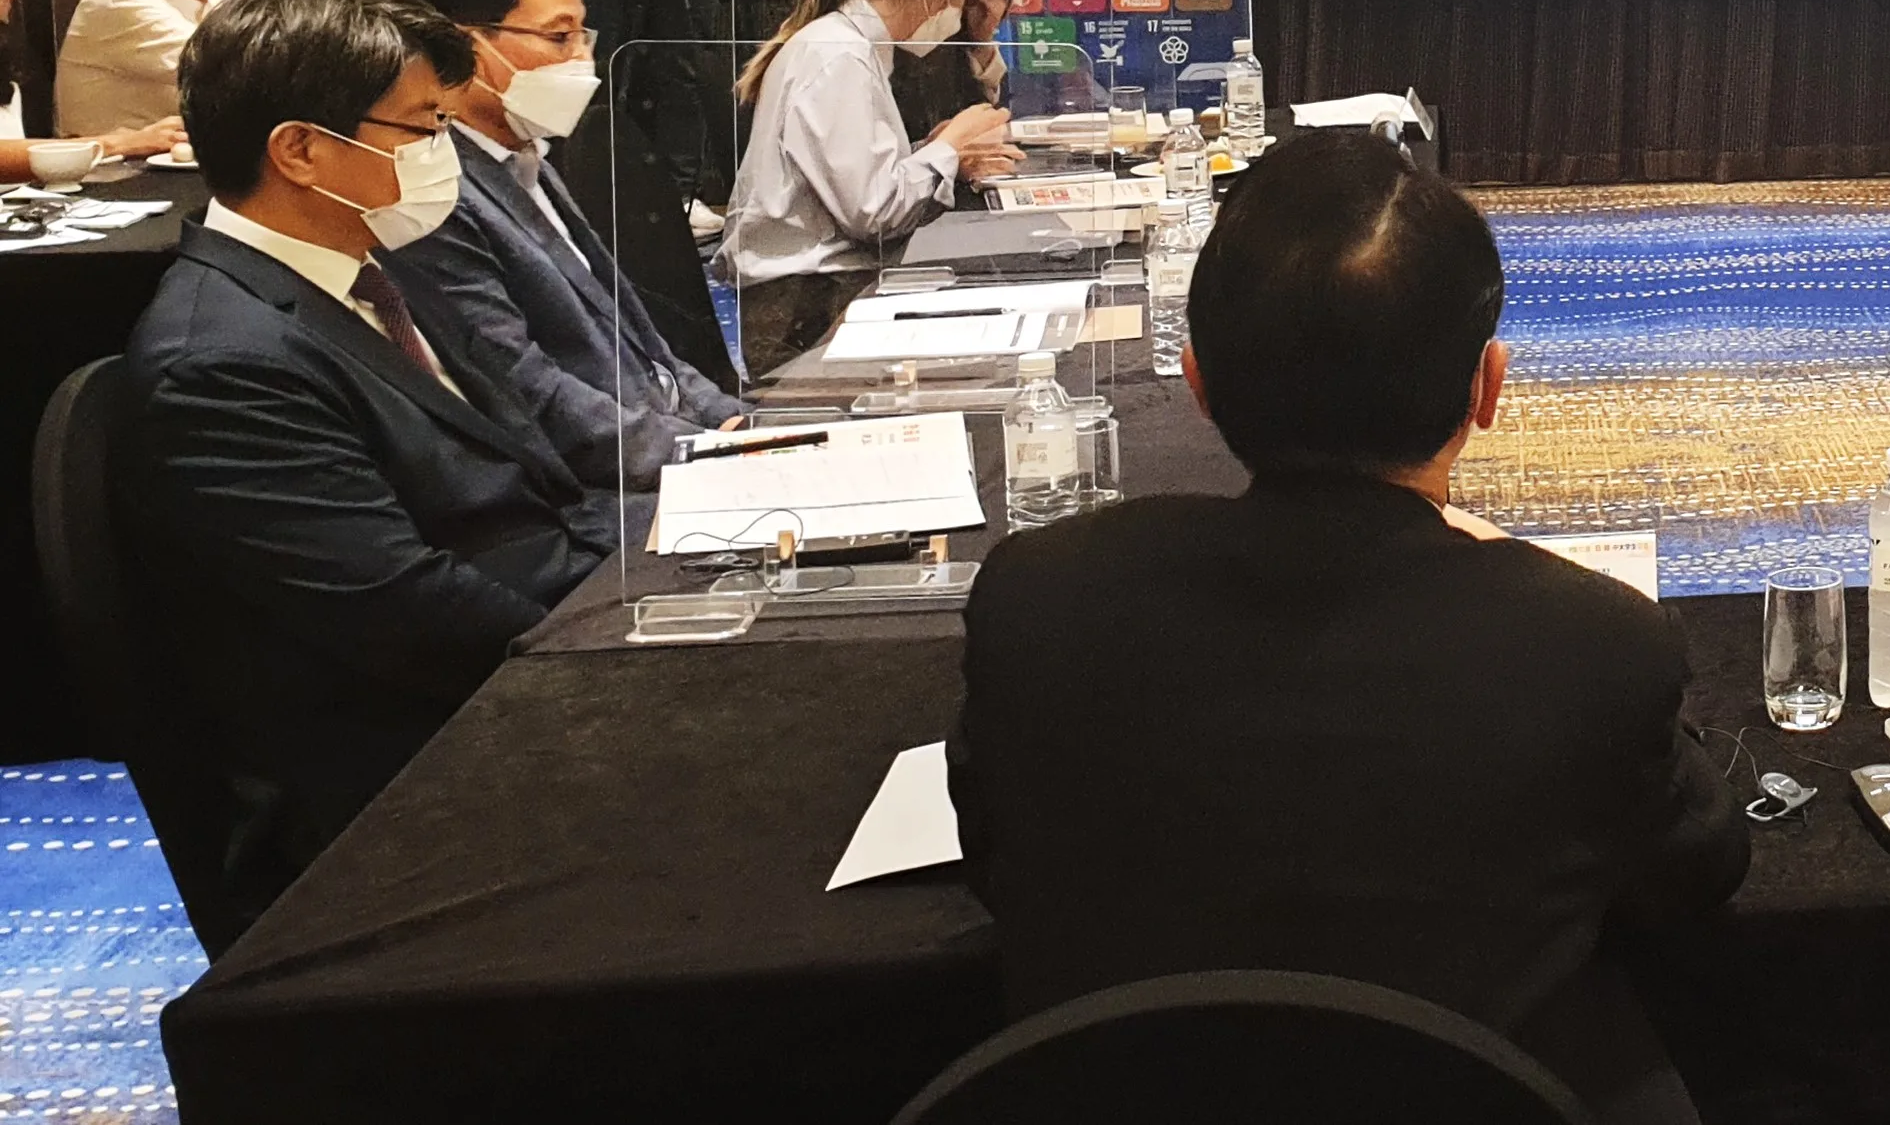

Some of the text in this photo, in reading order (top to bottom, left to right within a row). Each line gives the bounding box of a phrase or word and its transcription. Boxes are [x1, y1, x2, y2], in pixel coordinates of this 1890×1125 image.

[1020, 22, 1033, 34] 15
[1084, 21, 1096, 34] 16
[1147, 20, 1159, 33] 17
